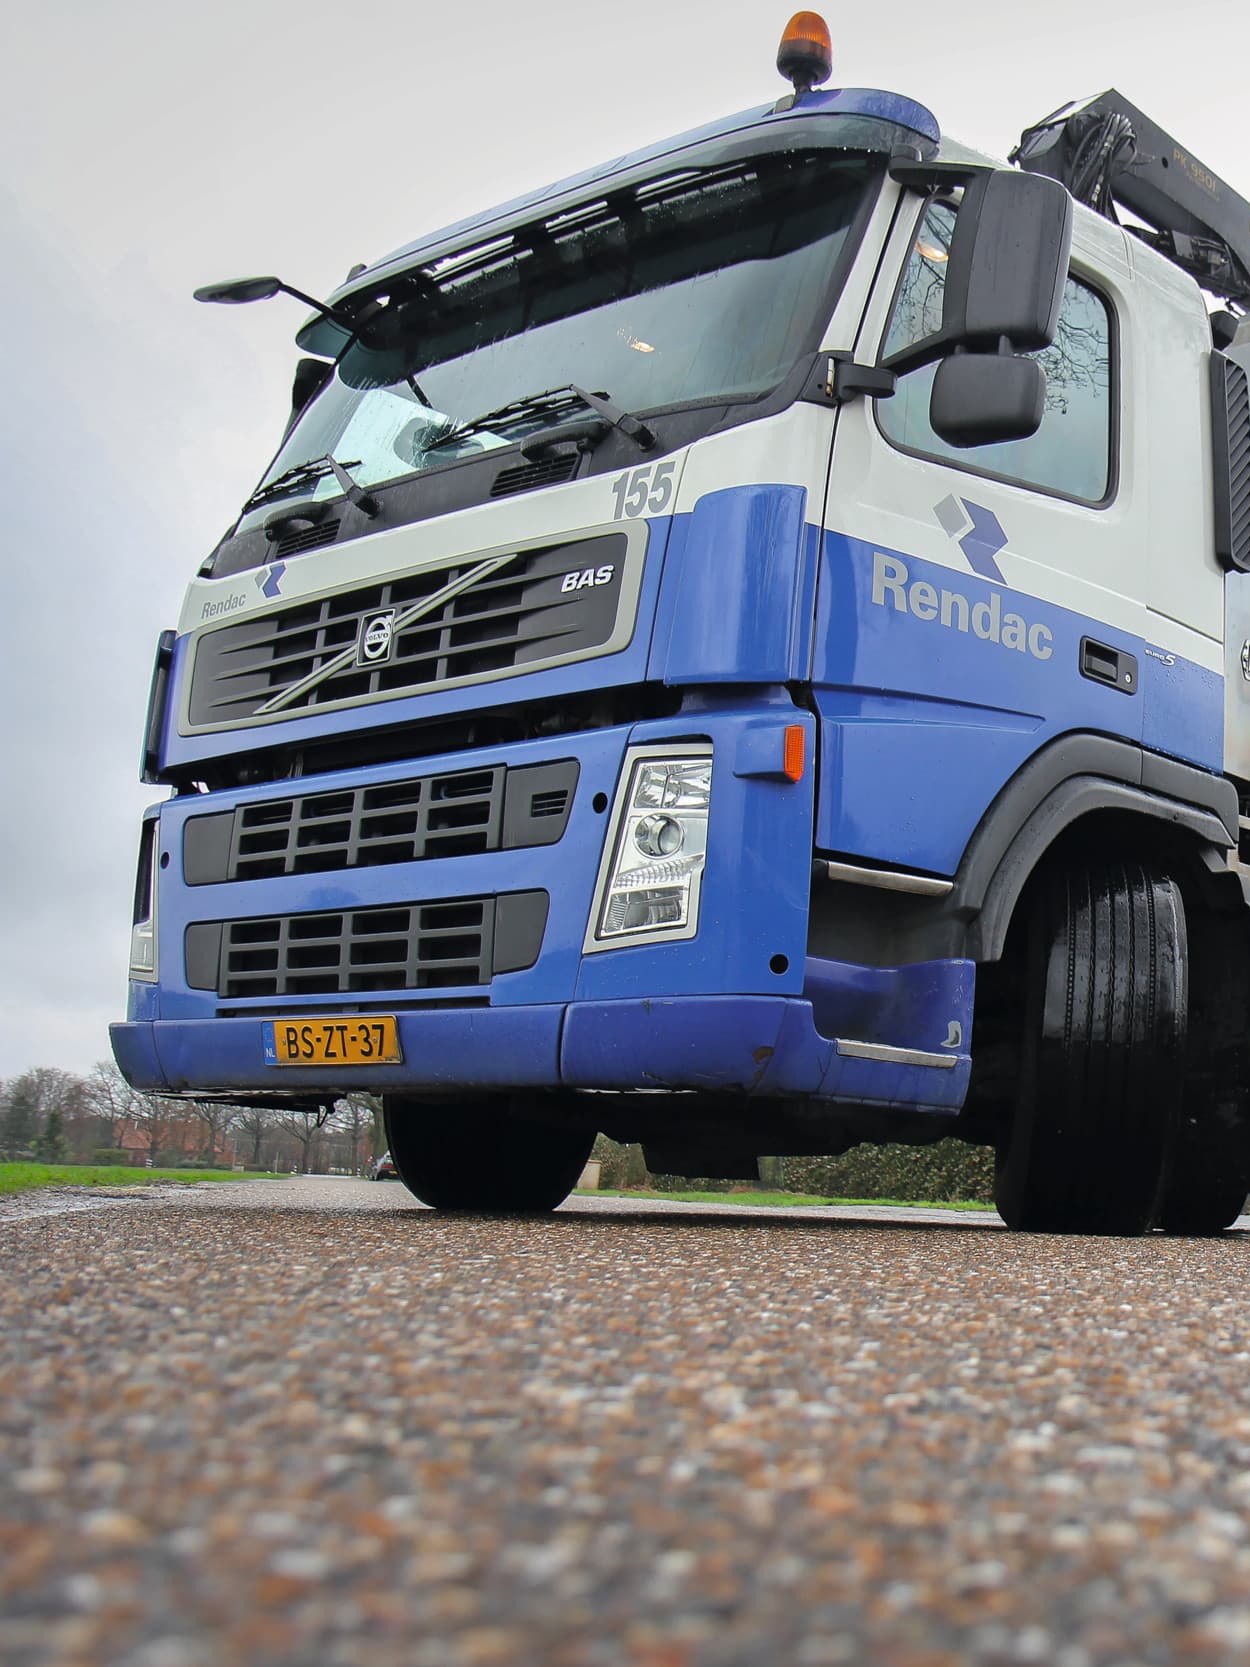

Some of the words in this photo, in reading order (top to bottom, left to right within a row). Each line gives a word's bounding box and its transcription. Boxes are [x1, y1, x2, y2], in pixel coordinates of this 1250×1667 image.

[612, 461, 676, 520] 155
[561, 564, 614, 593] BAS
[201, 594, 246, 619] Rendac
[872, 551, 1053, 660] Rendac
[265, 1047, 276, 1058] NL
[285, 1023, 385, 1059] BS-ZT-37
